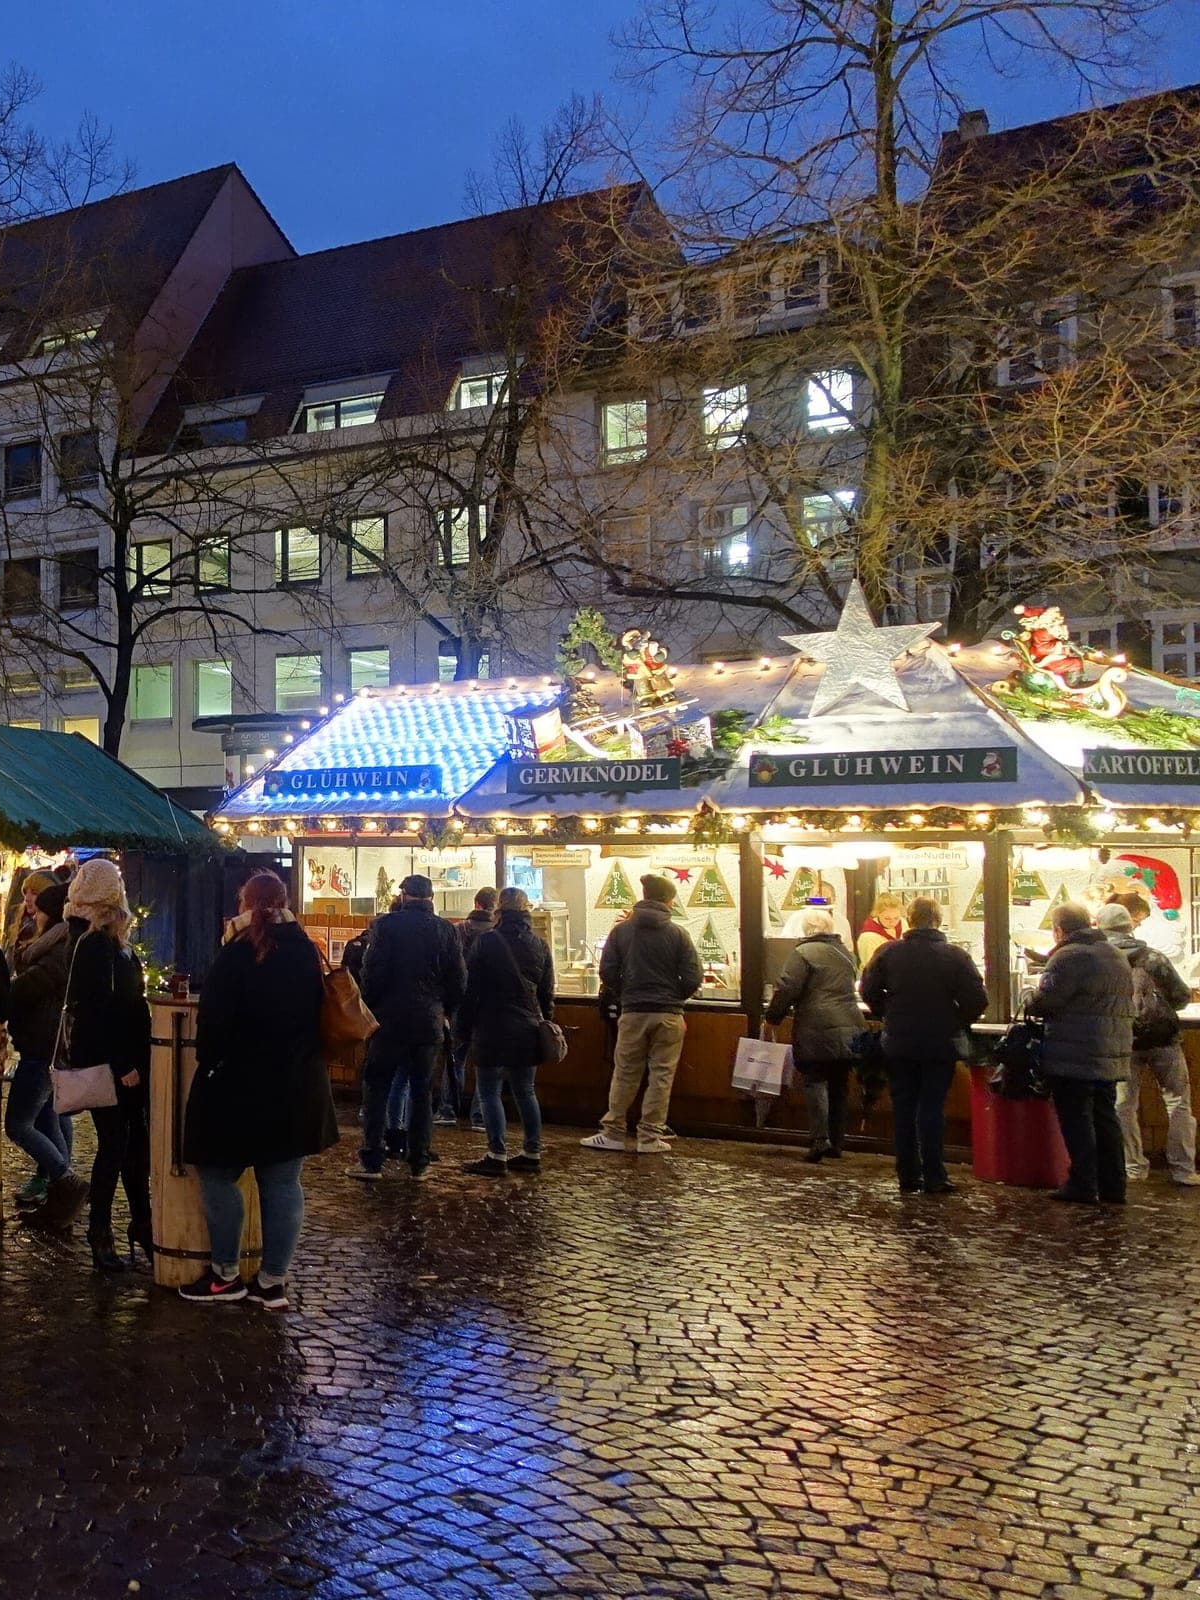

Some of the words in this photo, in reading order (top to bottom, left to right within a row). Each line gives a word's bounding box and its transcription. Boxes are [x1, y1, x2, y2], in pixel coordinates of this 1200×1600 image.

[519, 762, 669, 785] GERMKNÖDEL
[788, 753, 965, 778] GLÜHWEIN
[1083, 754, 1200, 775] KARTOFFEL
[290, 769, 409, 789] GLÜHWEIN
